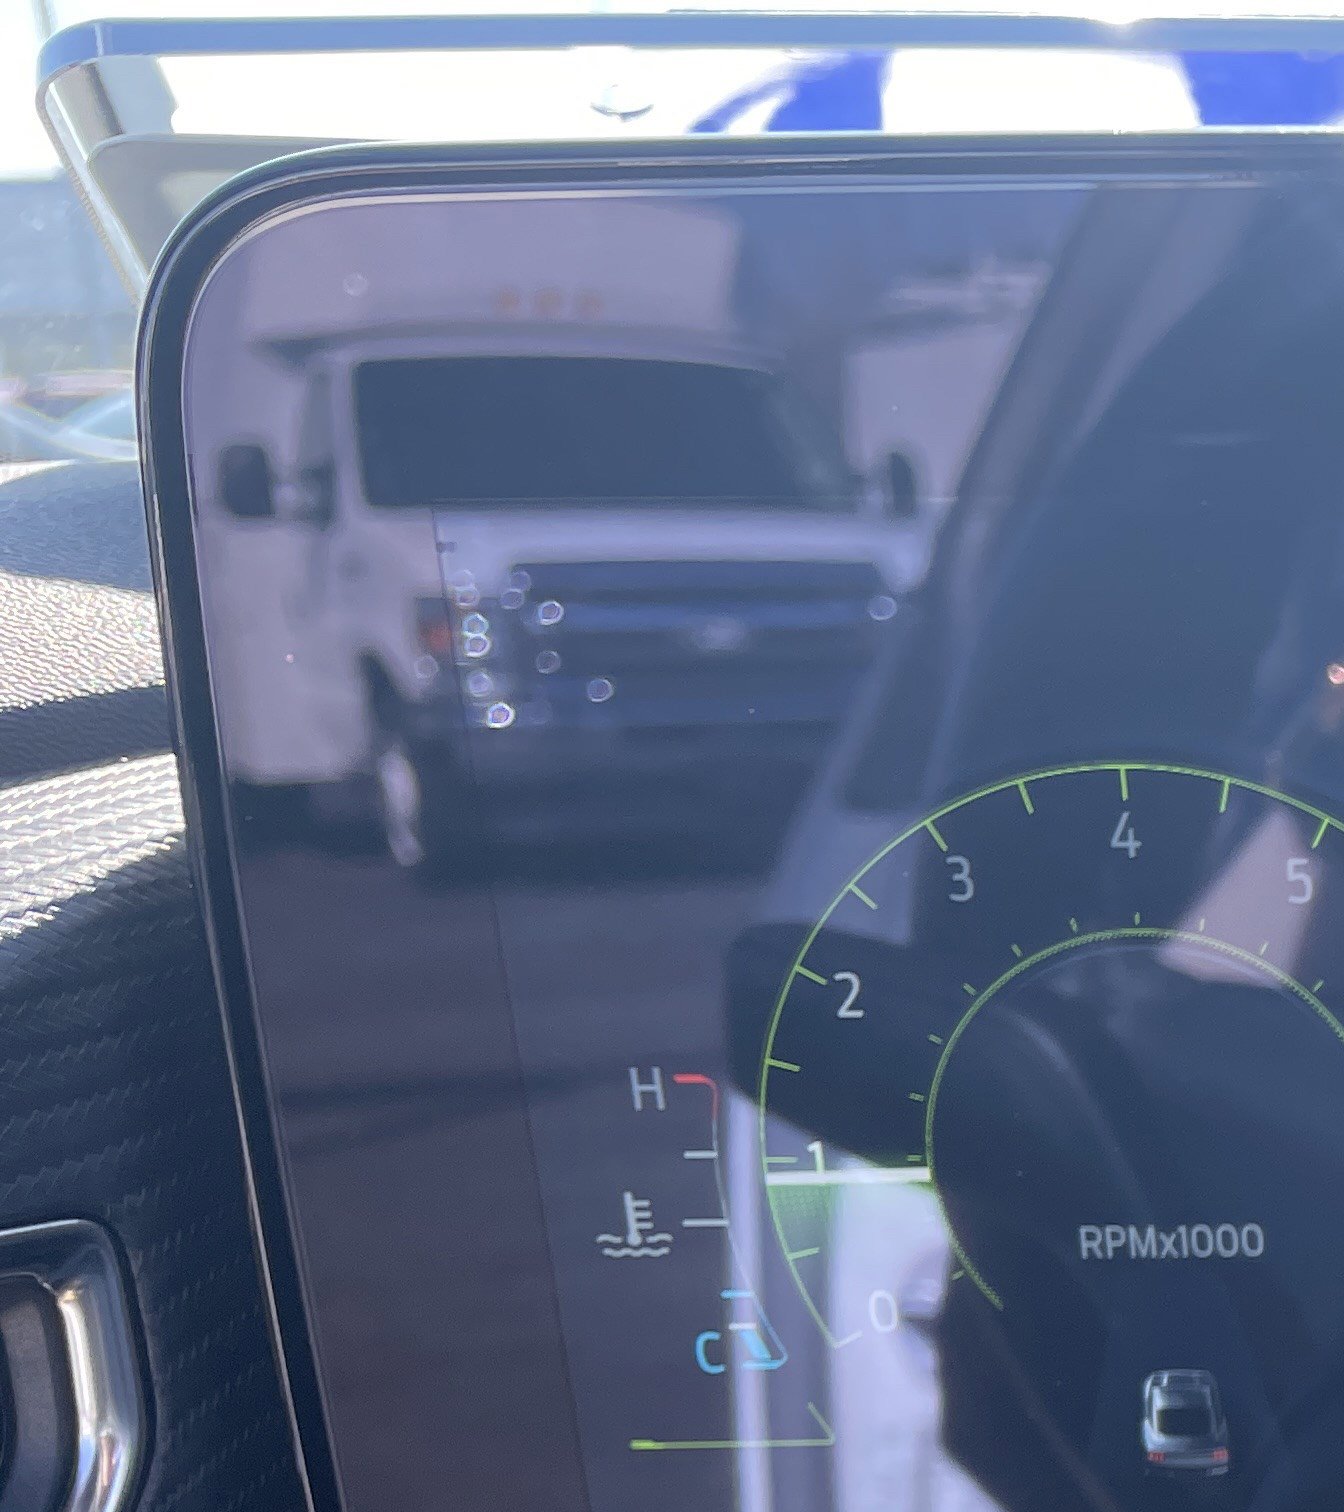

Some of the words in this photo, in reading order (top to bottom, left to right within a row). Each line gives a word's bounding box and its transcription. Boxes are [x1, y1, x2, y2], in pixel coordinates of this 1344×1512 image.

[1110, 810, 1142, 860] 4
[945, 855, 975, 903] 3
[1286, 857, 1314, 905] 5
[834, 970, 865, 1020] 2
[629, 1066, 667, 1112] H
[806, 1140, 826, 1174] 1
[1079, 1222, 1266, 1262] RPMx1000
[868, 1289, 899, 1334] 0
[694, 1331, 725, 1375] C
